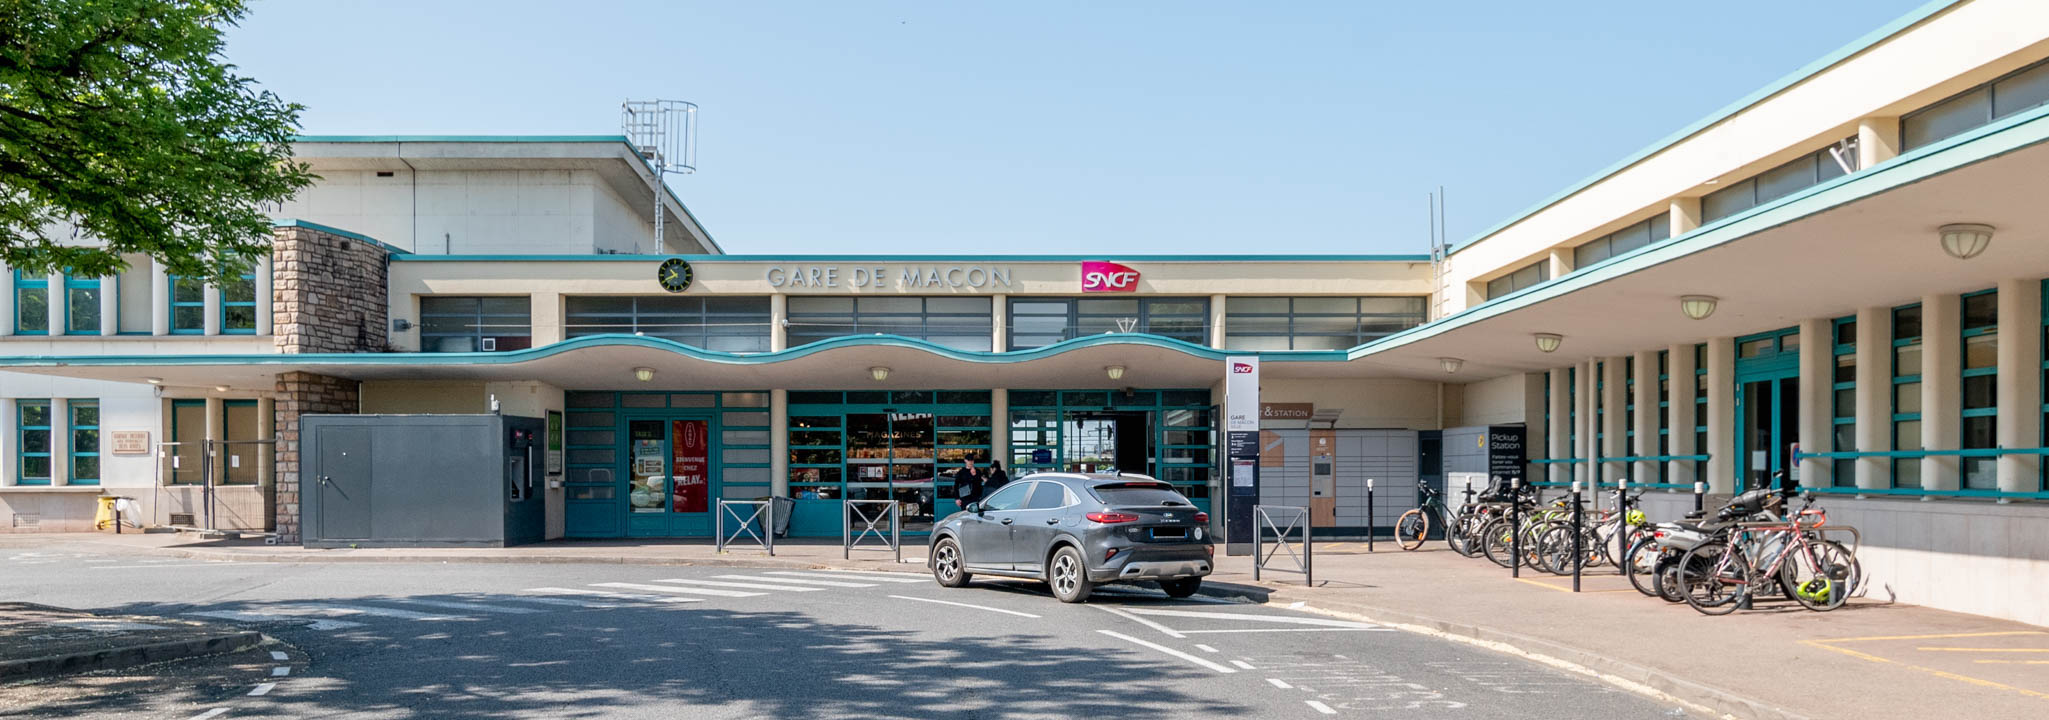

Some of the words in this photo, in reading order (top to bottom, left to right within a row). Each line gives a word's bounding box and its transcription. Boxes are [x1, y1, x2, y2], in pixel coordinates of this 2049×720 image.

[767, 266, 838, 287] GARE
[854, 266, 886, 288] DE
[902, 266, 1012, 287] MACON
[1083, 271, 1138, 289] SNCF
[1264, 406, 1273, 417] &
[1273, 409, 1308, 417] STATION
[866, 431, 922, 439] MAGAZINES
[1491, 433, 1519, 442] Pickup
[676, 474, 701, 486] RELAY
